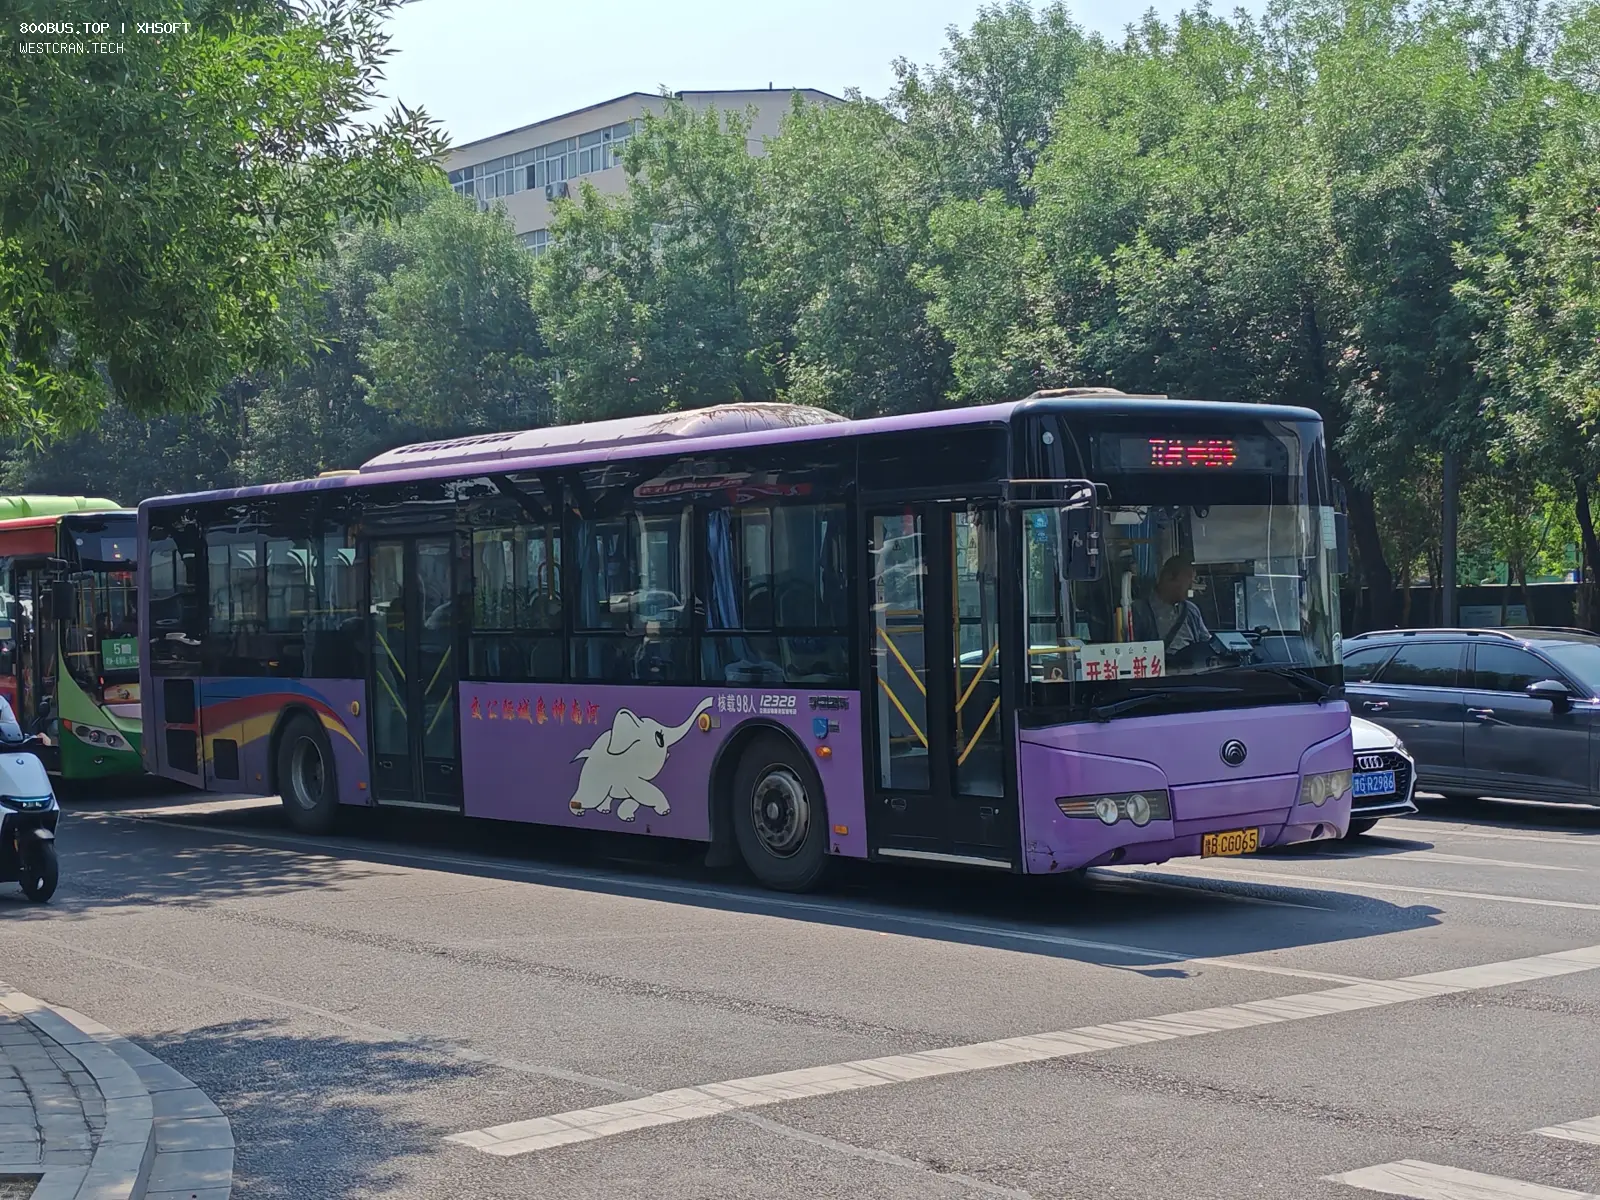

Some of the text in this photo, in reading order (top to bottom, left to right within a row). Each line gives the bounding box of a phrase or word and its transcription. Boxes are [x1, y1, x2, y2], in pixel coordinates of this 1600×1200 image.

[717, 694, 757, 714] 核载98人
[760, 694, 797, 707] 12328
